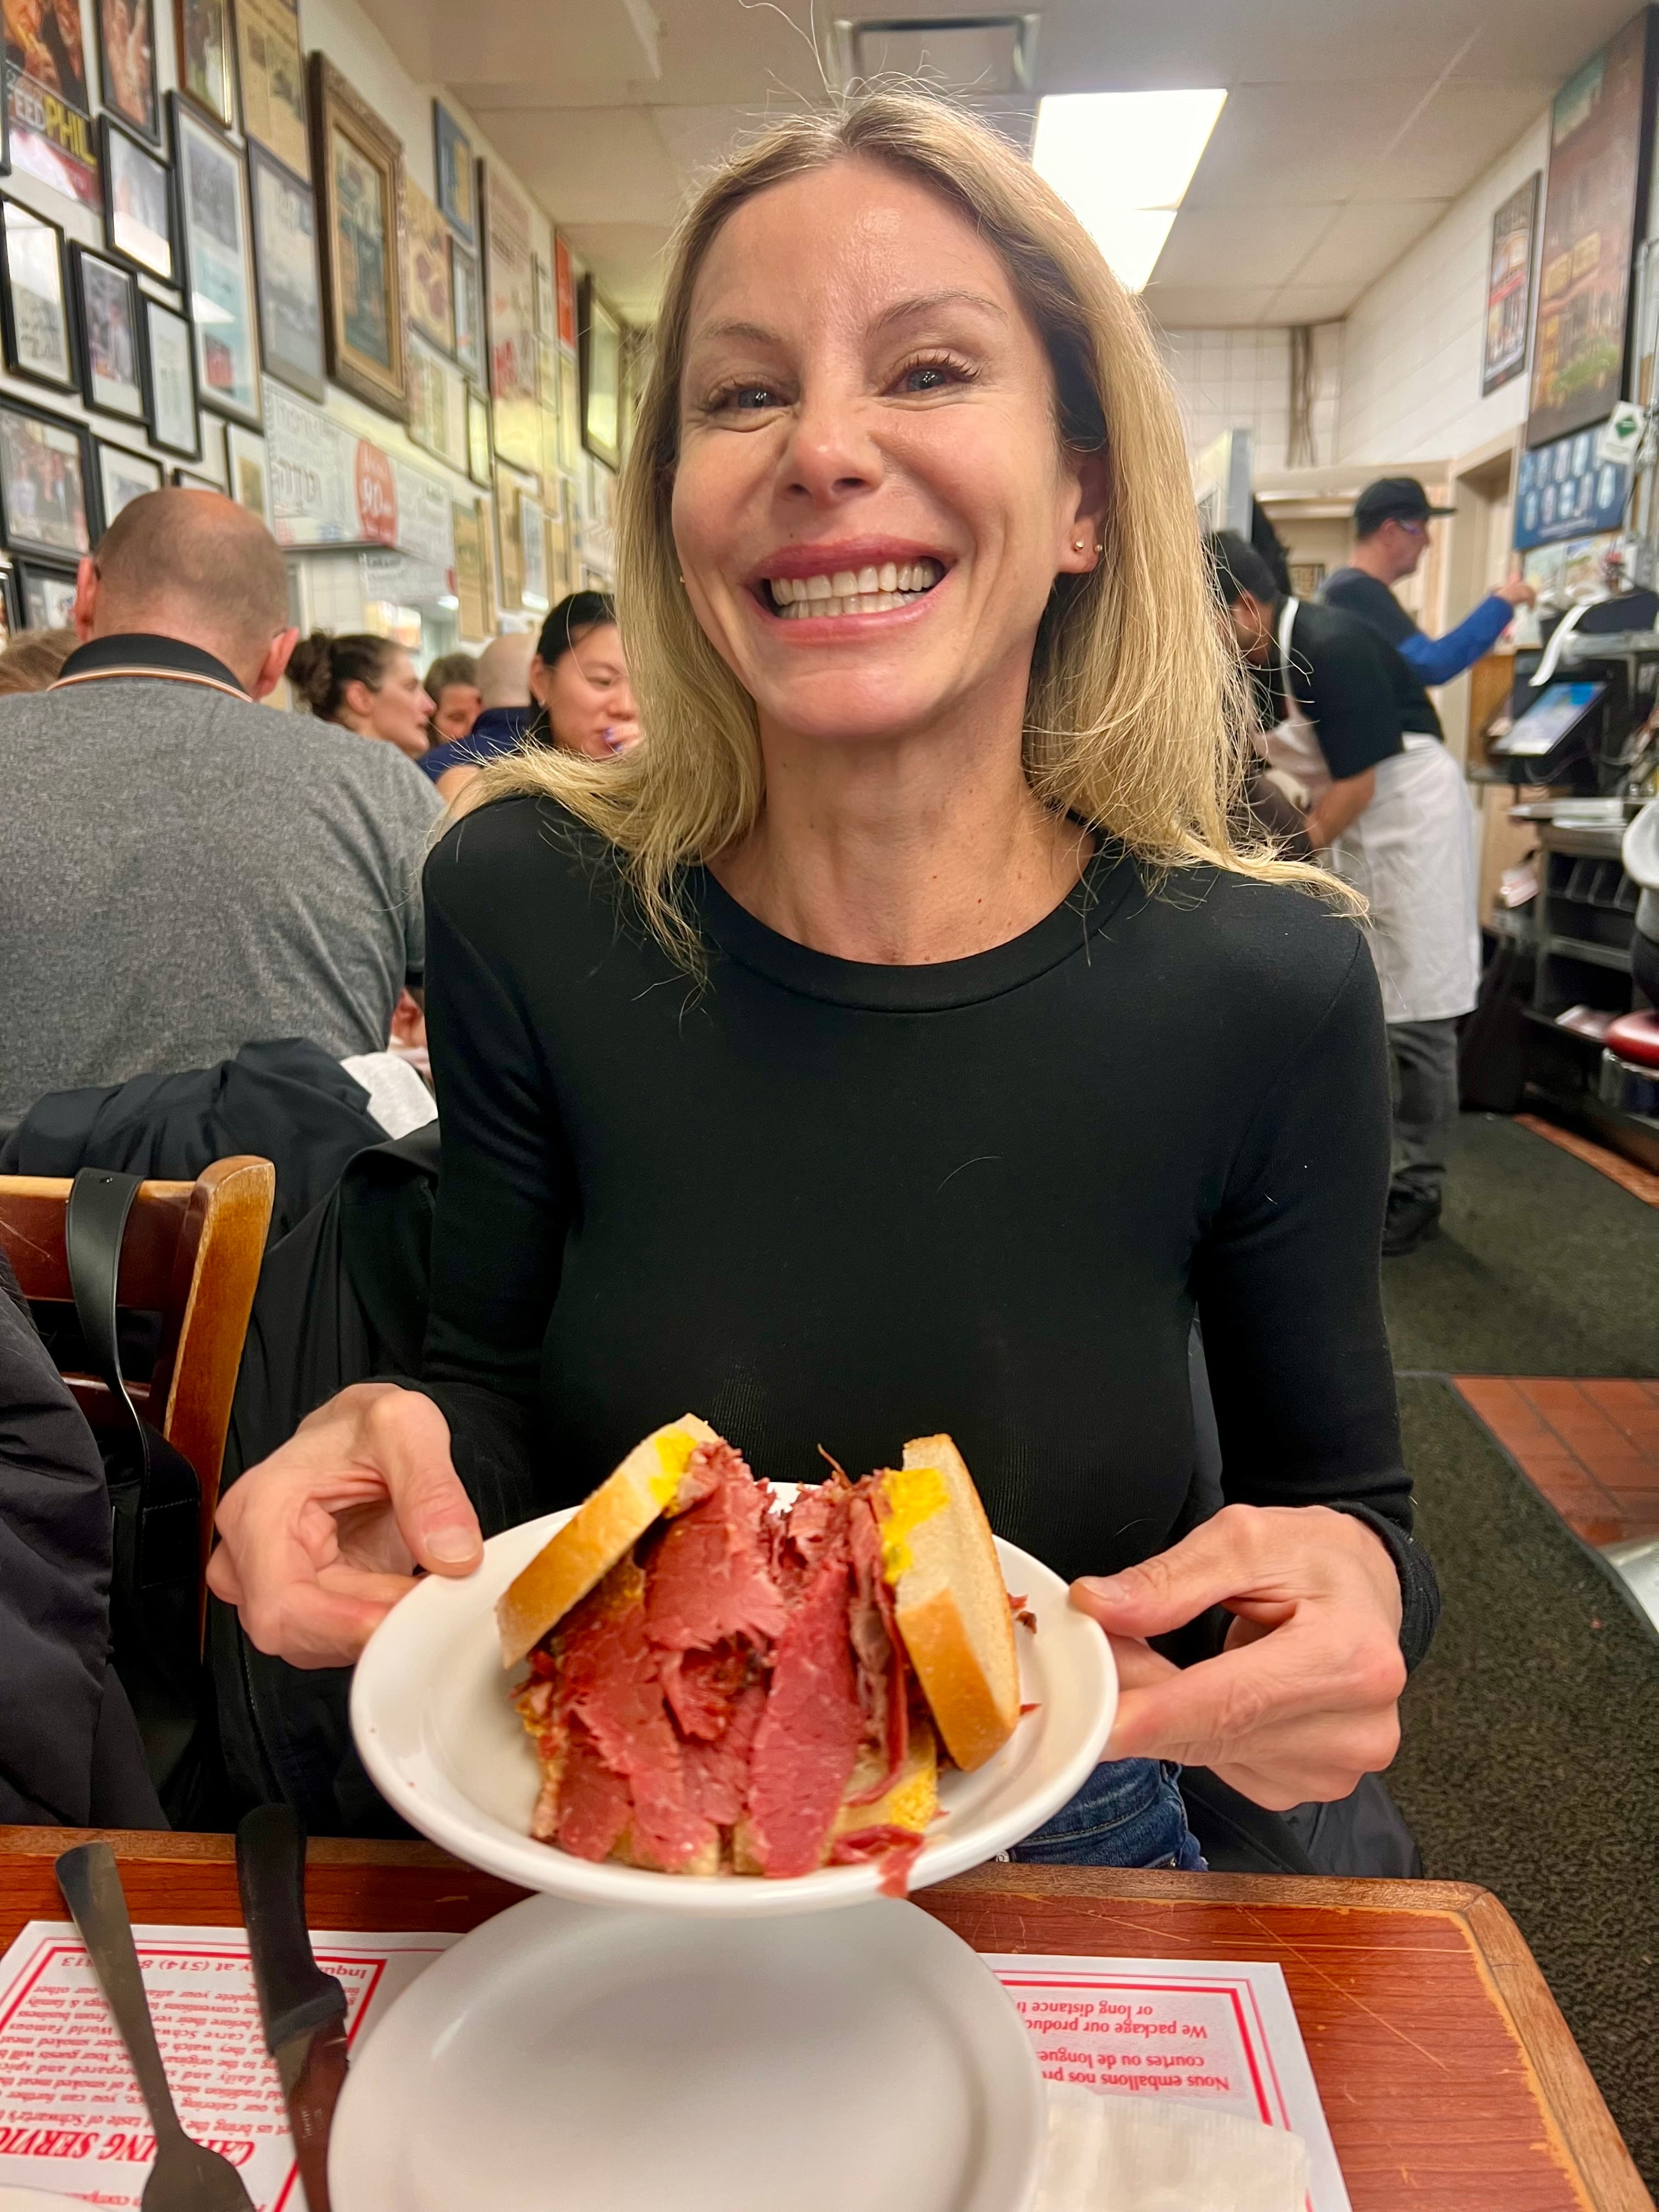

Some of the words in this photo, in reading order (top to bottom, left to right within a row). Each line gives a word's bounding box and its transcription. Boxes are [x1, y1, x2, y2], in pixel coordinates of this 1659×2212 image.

[43, 93, 98, 166] PHIL
[160, 1960, 210, 1971] (514)
[215, 1963, 235, 1972] at
[31, 1986, 70, 1995] other
[26, 1996, 65, 2008] family
[163, 2003, 240, 2013] conventions
[1031, 2002, 1094, 2017] distance
[1099, 2000, 1131, 2019] long
[1136, 2006, 1153, 2016] or
[18, 2011, 71, 2022] business
[8, 2023, 64, 2034] Famous
[67, 2025, 112, 2035] World
[210, 2018, 252, 2030] before
[1082, 2022, 1110, 2033] our
[1114, 2021, 1177, 2038] package
[204, 2032, 244, 2040] carve
[1182, 2025, 1207, 2039] We
[37, 2038, 91, 2047] smoked
[173, 2043, 211, 2052] watch
[217, 2060, 238, 2070] the
[1097, 2054, 1116, 2069] de
[1121, 2055, 1142, 2065] ou
[1146, 2056, 1205, 2069] courtes
[180, 2072, 211, 2081] and
[218, 2072, 256, 2085] daily
[1068, 2072, 1096, 2084] nos
[1101, 2074, 1182, 2091] emballons
[1187, 2076, 1230, 2090] Nous
[6, 2091, 55, 2103] further
[91, 2093, 117, 2103] you
[205, 2087, 262, 2099] tradition
[180, 2097, 238, 2112] catering
[243, 2104, 268, 2112] our
[186, 2120, 210, 2134] the
[213, 2119, 252, 2137] bring
